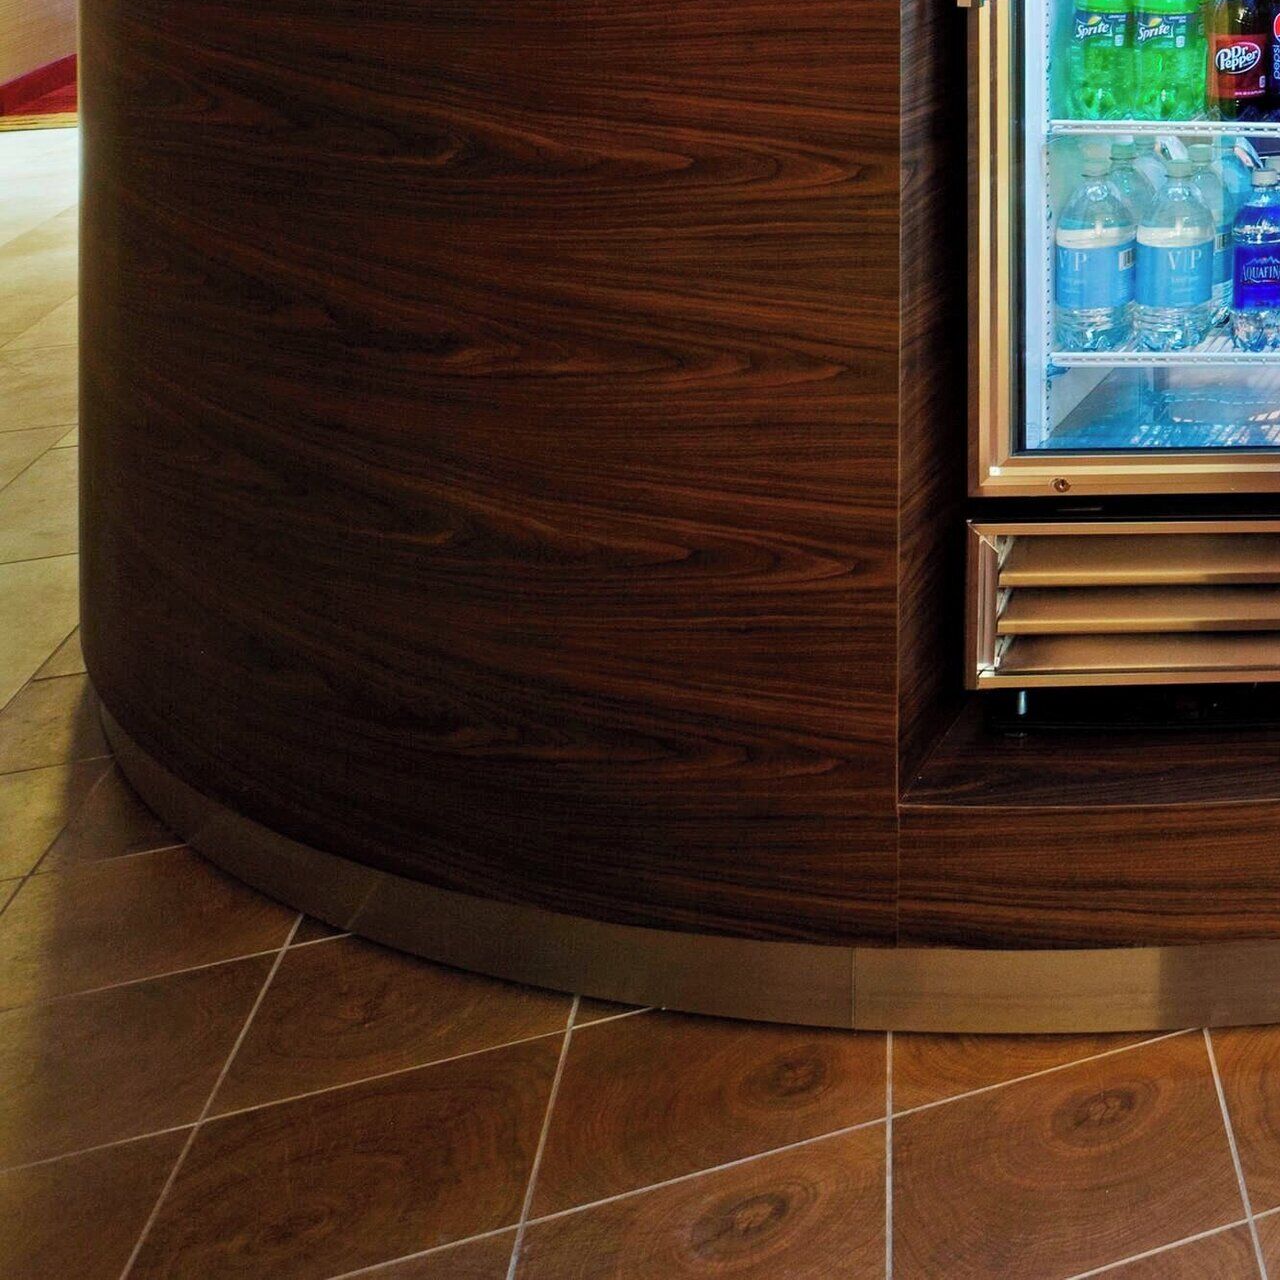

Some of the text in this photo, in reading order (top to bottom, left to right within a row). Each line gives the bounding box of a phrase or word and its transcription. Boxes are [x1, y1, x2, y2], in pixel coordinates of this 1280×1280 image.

[1075, 23, 1110, 40] Sprite
[1137, 24, 1171, 41] Sprite
[1218, 49, 1259, 71] Pepper
[1229, 45, 1247, 58] Dr
